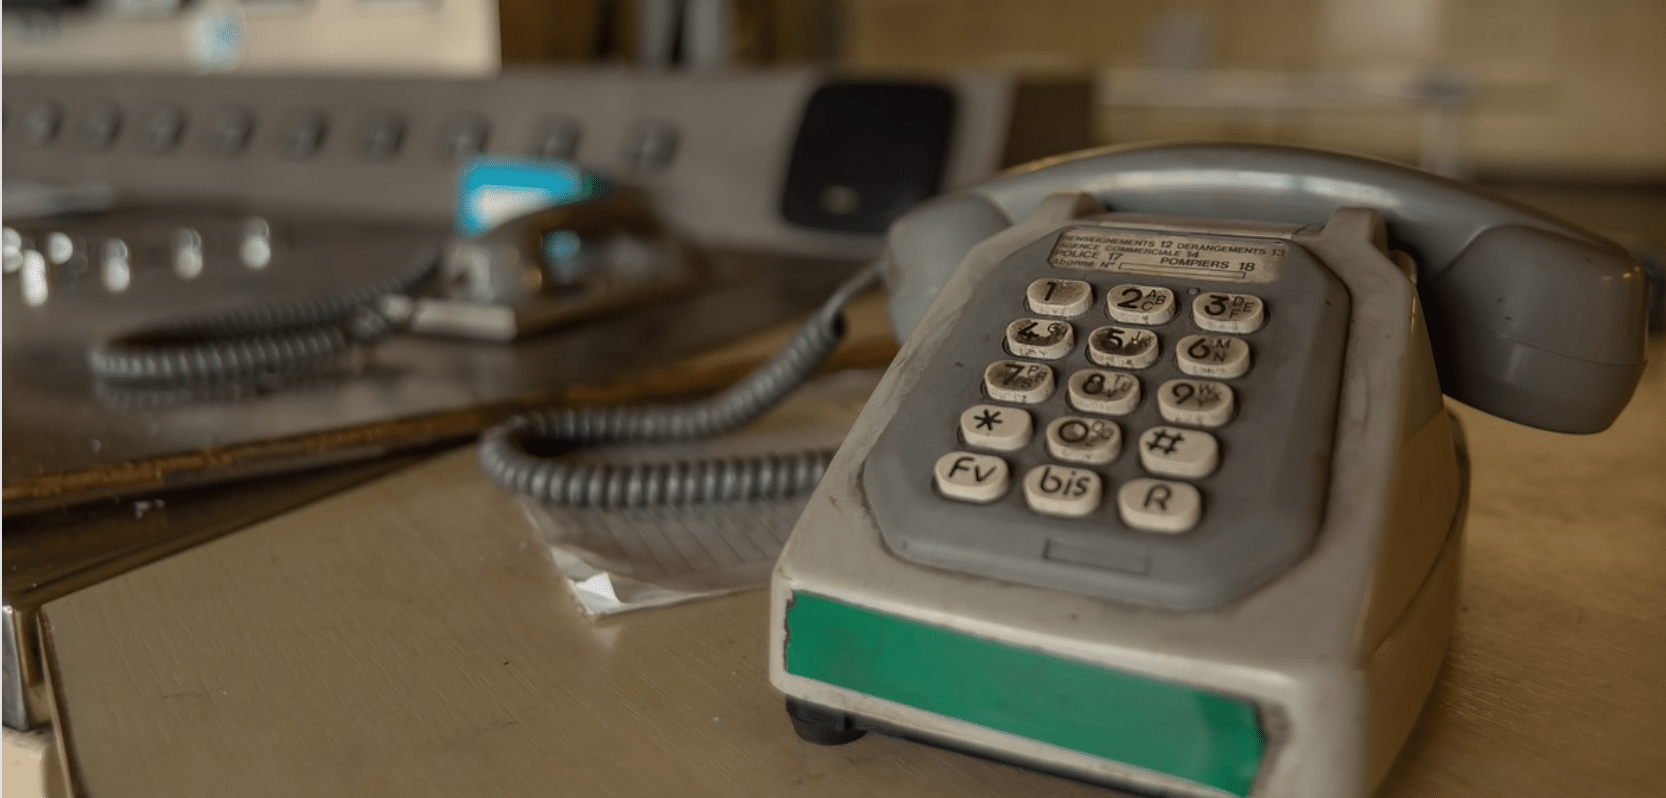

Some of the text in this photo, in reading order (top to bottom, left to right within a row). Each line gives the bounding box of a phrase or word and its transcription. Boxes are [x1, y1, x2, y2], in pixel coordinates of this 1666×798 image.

[1059, 241, 1101, 251] AGENCE
[1105, 245, 1182, 257] COMMERCIALE
[1160, 240, 1174, 249] 12
[1176, 242, 1267, 255] DERANGEMENTS
[1272, 248, 1285, 257] 13
[1055, 248, 1256, 272] POLICE 17 POMPIERS 18
[1045, 282, 1057, 301] 1
[1117, 288, 1143, 309] 2
[1204, 295, 1230, 316] 3
[1017, 322, 1040, 341] 4
[1103, 327, 1125, 349] 5
[1188, 338, 1212, 359] 6
[1002, 362, 1025, 386] 7
[1082, 373, 1106, 395] 8
[1172, 383, 1195, 405] 9
[1040, 466, 1091, 496] bis
[1143, 484, 1172, 510] R
